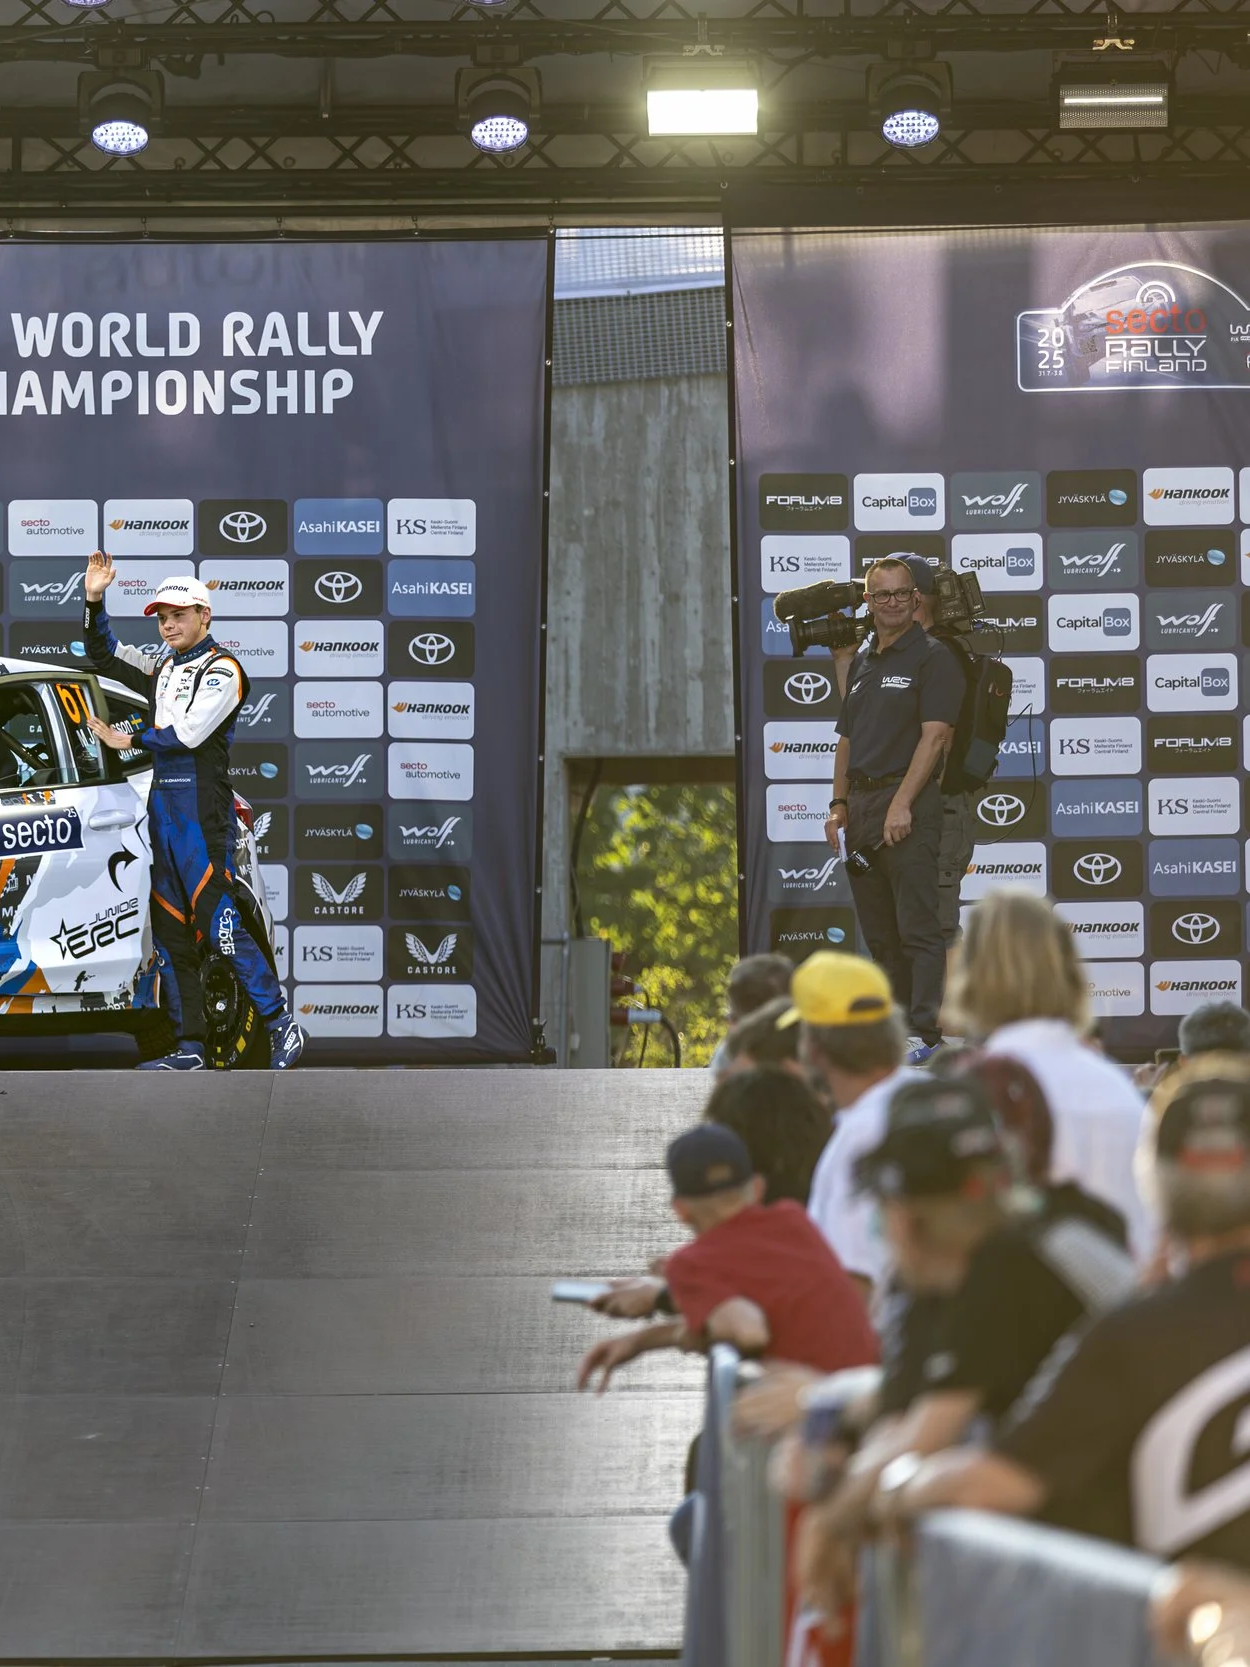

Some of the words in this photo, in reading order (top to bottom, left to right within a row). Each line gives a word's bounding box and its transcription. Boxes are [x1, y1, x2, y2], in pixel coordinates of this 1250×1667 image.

[1105, 302, 1207, 335] secto
[11, 312, 201, 358] WORLD
[222, 311, 384, 356] RALLY
[1037, 328, 1065, 347] 20
[1105, 339, 1207, 357] RALLY
[1037, 351, 1065, 369] 25
[1105, 359, 1207, 373] FINLAND
[766, 495, 843, 505] FORUM8
[1057, 493, 1106, 504] JYVÄSKYLÄ
[20, 518, 50, 527] secto
[396, 519, 427, 535] KS
[26, 526, 85, 535] automotive
[1156, 553, 1204, 564] JYVÄSKYLÄ
[770, 556, 801, 573] KS
[117, 579, 148, 587] secto
[20, 643, 68, 655] JYVÄSKYLÄ
[882, 676, 912, 684] WRC
[1056, 677, 1134, 688] FORUM8
[306, 700, 336, 709] secto
[311, 708, 370, 717] automotive
[783, 742, 837, 753] HANKOO
[1059, 738, 1090, 755] KS
[1154, 737, 1232, 748] FORUM8
[400, 762, 428, 770] secto
[405, 769, 461, 780] automotive
[778, 803, 807, 812] secto
[1157, 799, 1189, 815] KS
[2, 815, 72, 850] secto
[304, 827, 353, 837] JYVÄSKYLÄ
[399, 888, 446, 898] JYVÄSKYLÄ
[88, 898, 139, 926] JUNIOR
[314, 906, 364, 915] CASTORE
[67, 909, 140, 959] ERC
[218, 907, 236, 955] sparco
[778, 930, 825, 942] JYVÄSKYLÄ
[302, 945, 333, 962] KS
[407, 966, 458, 975] CASTORE
[396, 1003, 427, 1019] KS
